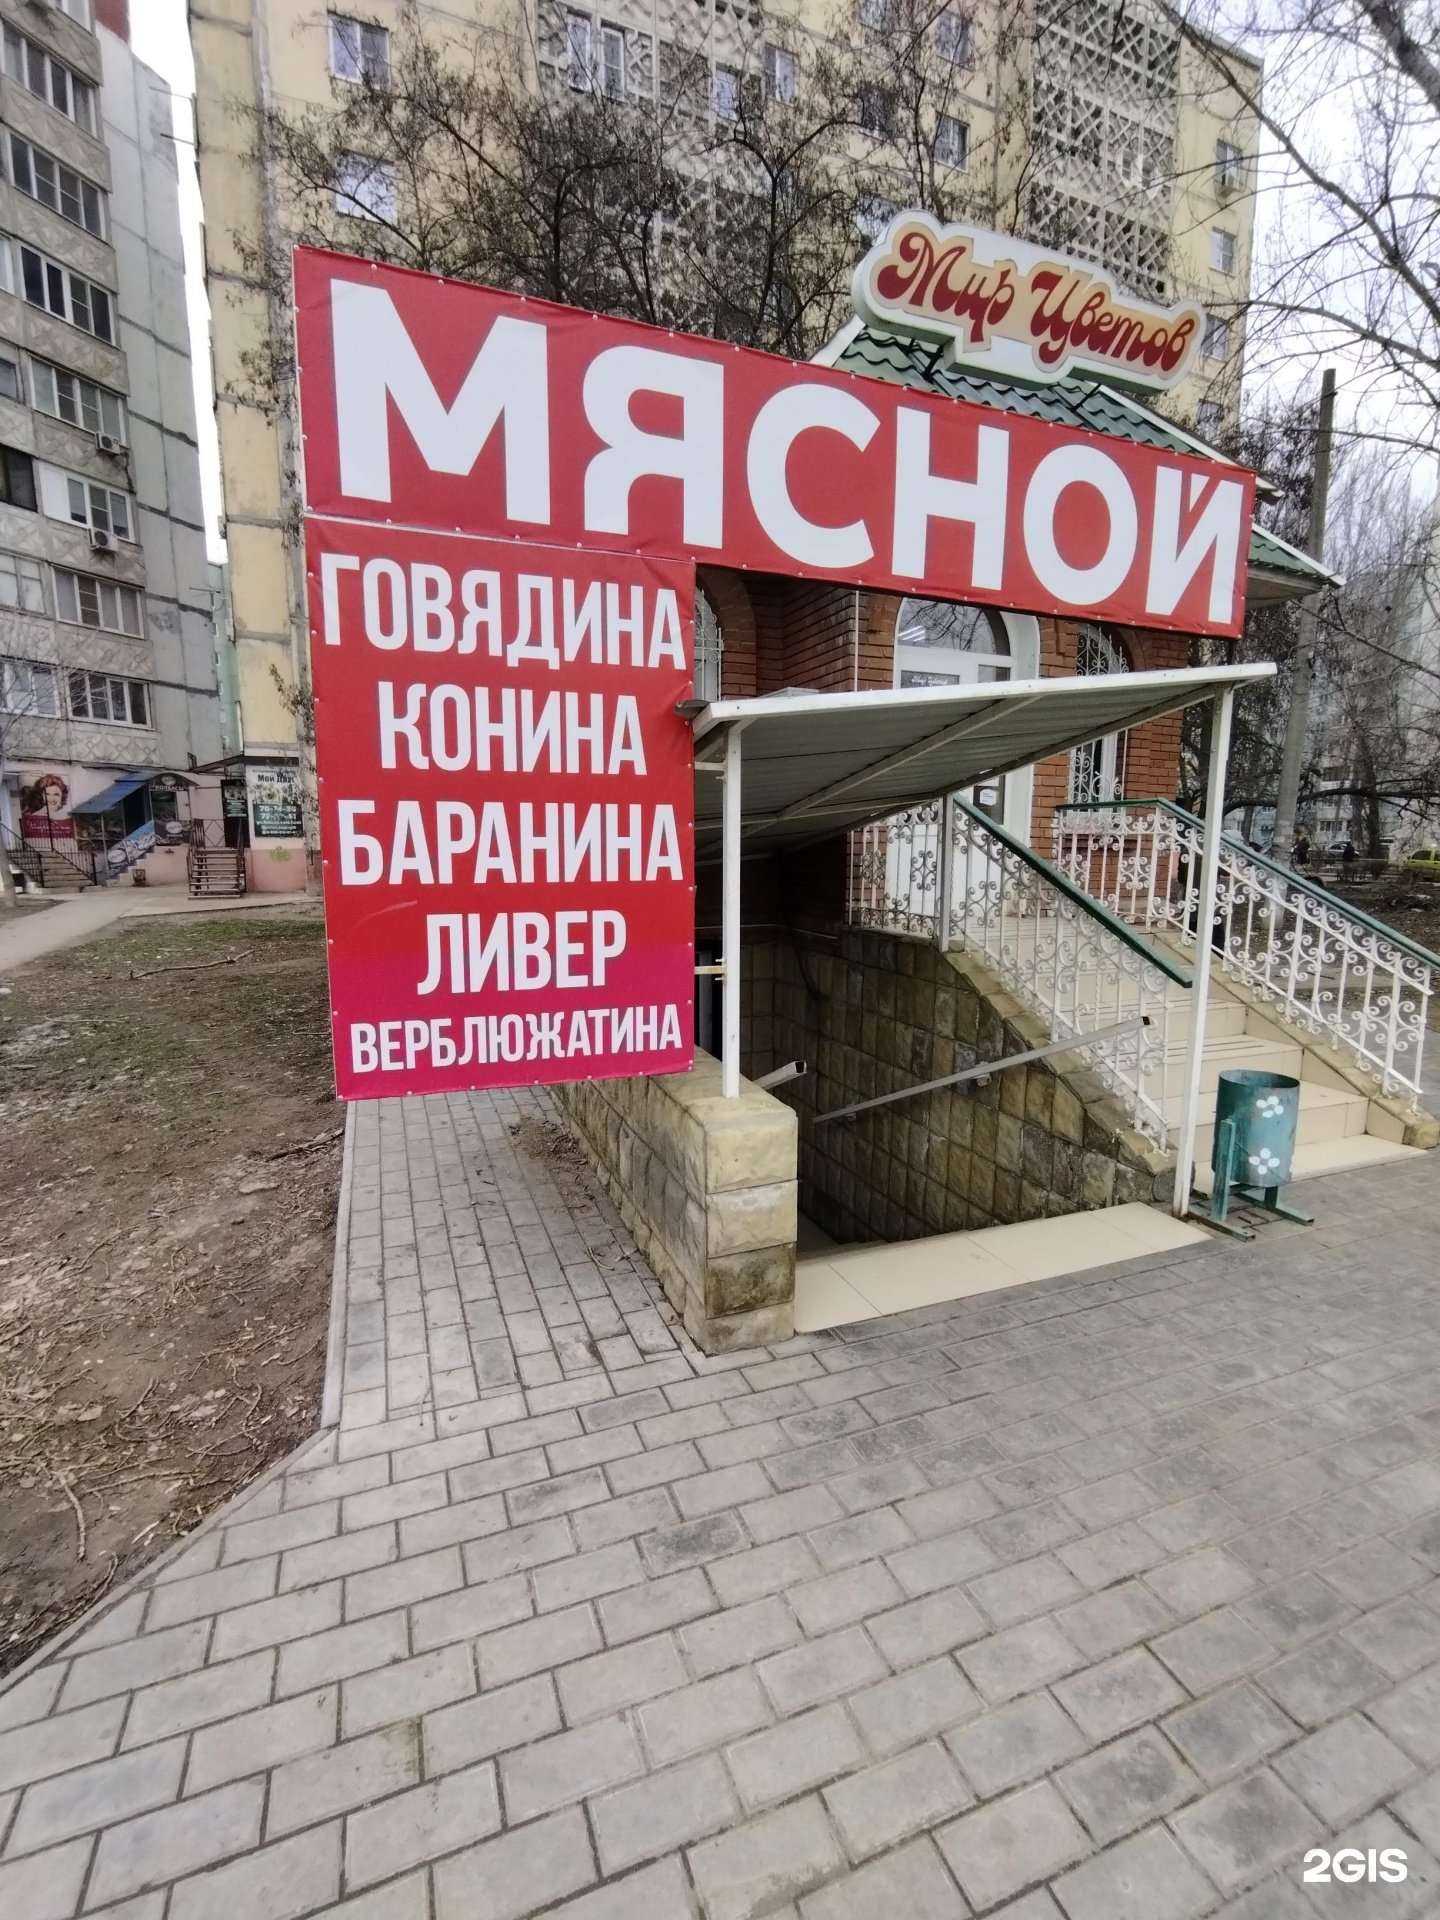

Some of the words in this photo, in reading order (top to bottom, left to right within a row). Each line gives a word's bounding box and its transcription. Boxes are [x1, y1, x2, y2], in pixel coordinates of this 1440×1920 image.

[877, 232, 1015, 343] Мир
[1030, 270, 1195, 372] Цветов
[330, 278, 1244, 624] МЯСНОЙ
[320, 552, 687, 671] ГОВЯДИНА
[378, 680, 648, 776] КОНИНА
[337, 799, 684, 886] БАРАНИНА
[416, 909, 628, 996] ЛИВЕР
[350, 1003, 684, 1074] ВЕРБЛЮЖАТИНА
